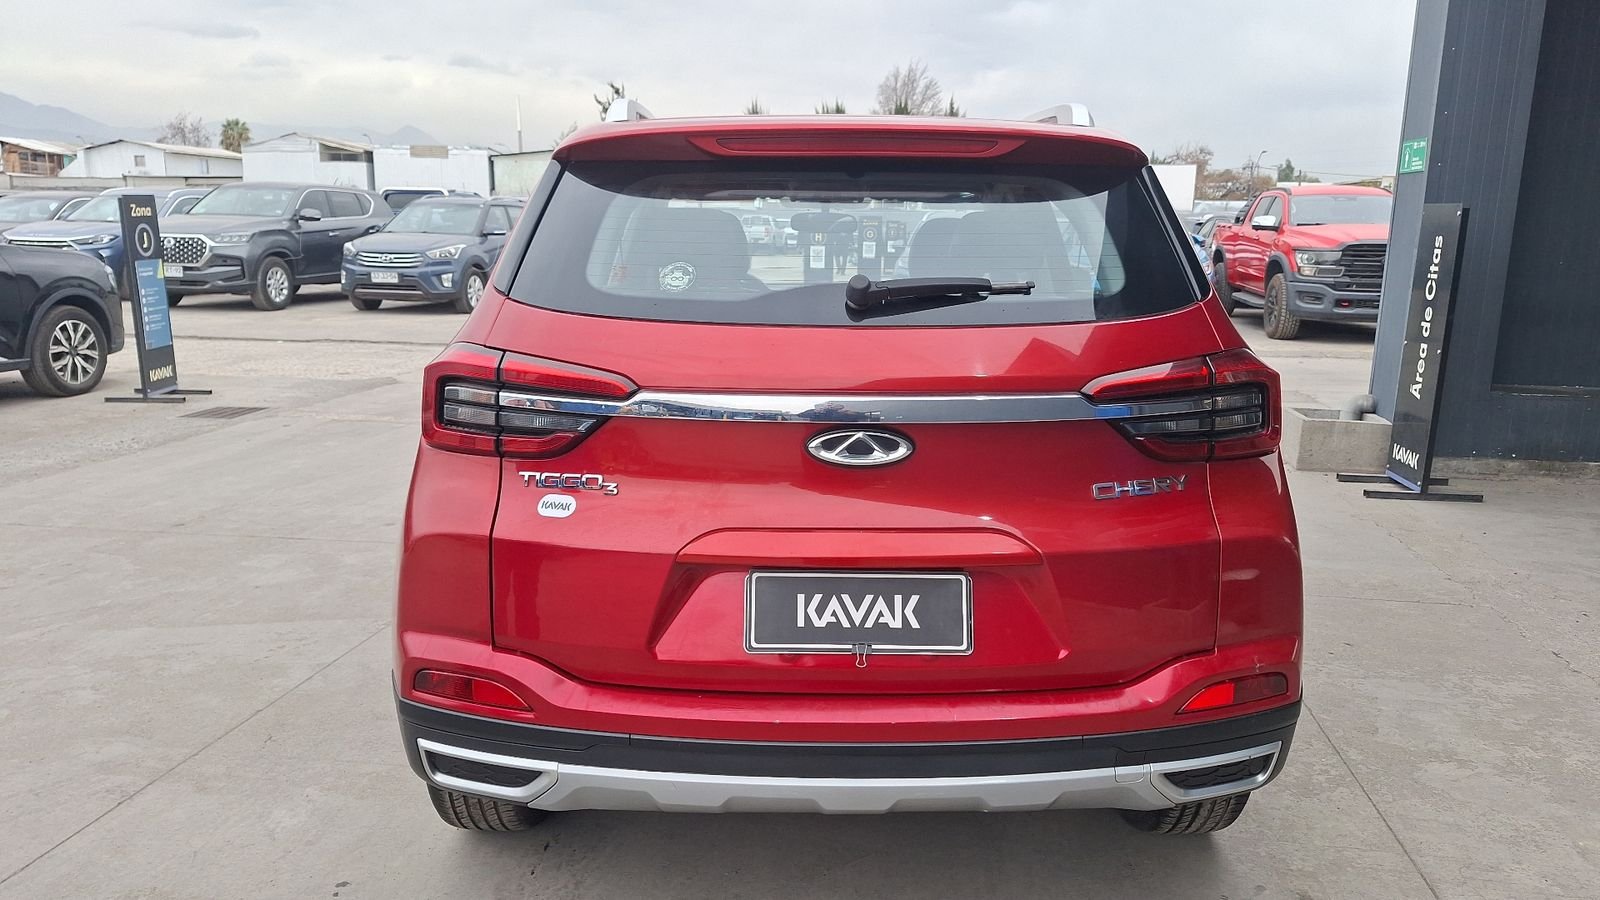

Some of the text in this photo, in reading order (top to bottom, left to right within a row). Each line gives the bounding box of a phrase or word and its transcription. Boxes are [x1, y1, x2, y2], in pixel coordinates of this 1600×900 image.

[130, 204, 152, 217] Zona
[142, 231, 148, 249] J
[815, 232, 822, 241] H
[866, 230, 874, 238] G
[1409, 235, 1444, 400] Área de Citas
[149, 364, 174, 382] KAVAK
[1392, 442, 1420, 470] KAVAK
[1092, 474, 1186, 500] CHERY
[541, 500, 572, 511] KAVAK
[796, 593, 921, 628] KAVAK
